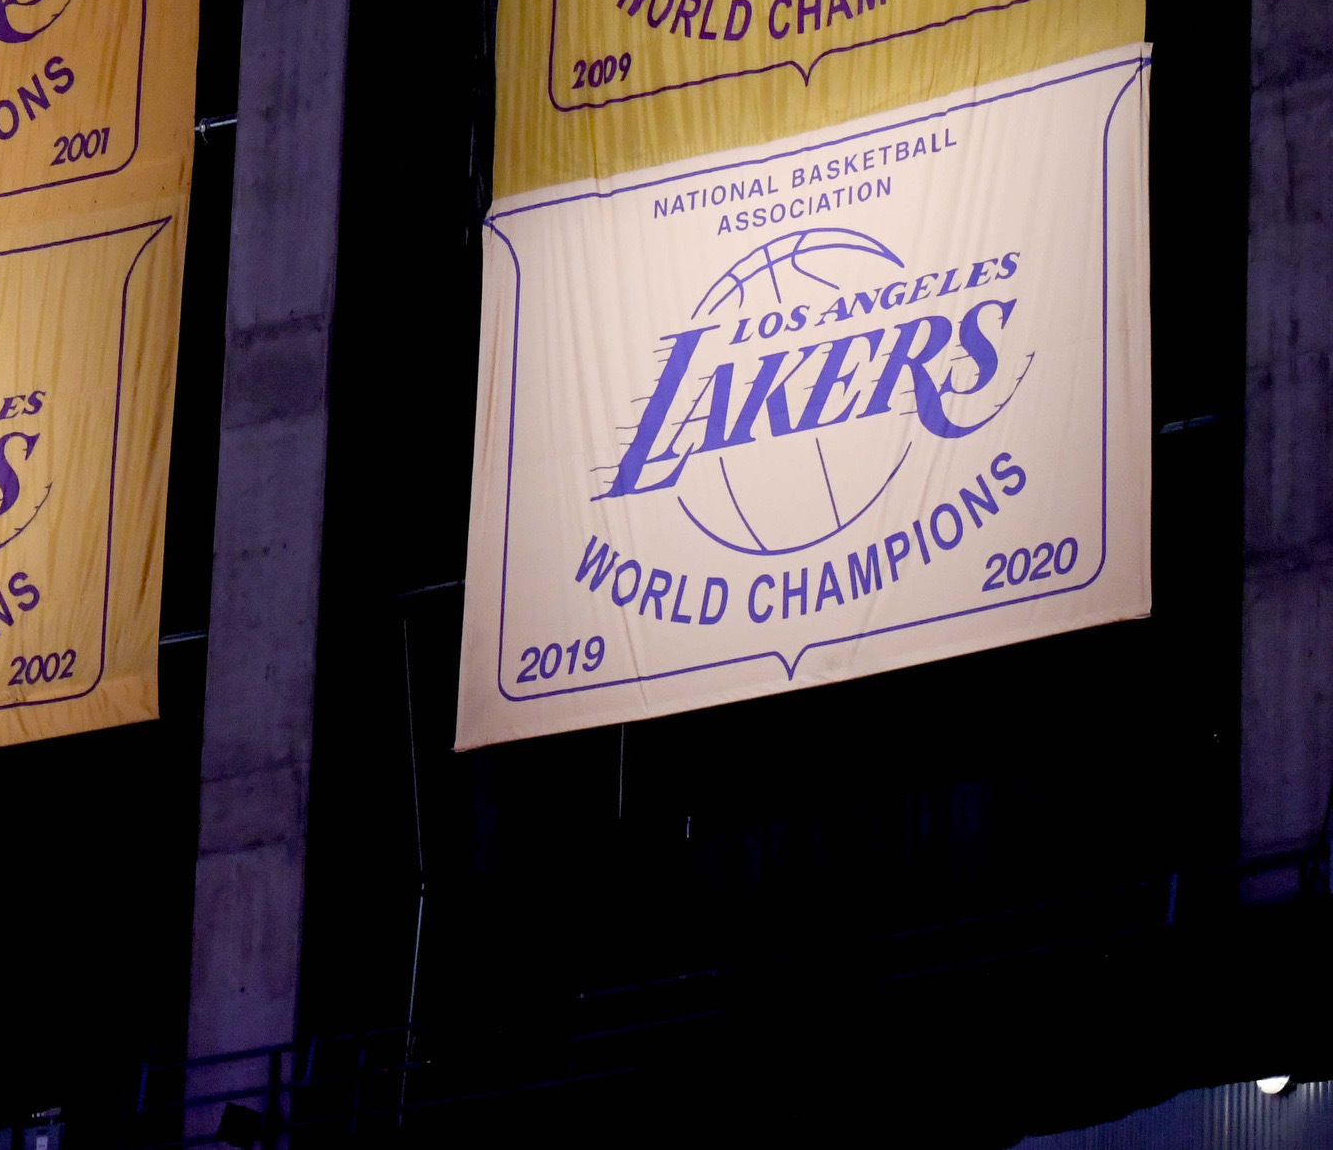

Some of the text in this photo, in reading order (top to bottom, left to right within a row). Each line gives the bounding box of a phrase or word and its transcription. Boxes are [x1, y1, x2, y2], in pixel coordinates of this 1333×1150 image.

[572, 53, 632, 88] 2009
[51, 127, 111, 165] 2001
[653, 129, 957, 218] NATIONAL BASKETBALL
[717, 177, 892, 235] ASSOCIATION
[730, 252, 1021, 344] LOS ANGELES
[590, 299, 1018, 502] LAKERS
[575, 452, 1028, 625] WORLD CHAMPIONS
[981, 538, 1079, 591] 2020
[8, 649, 77, 687] 2002
[517, 636, 605, 683] 2019
